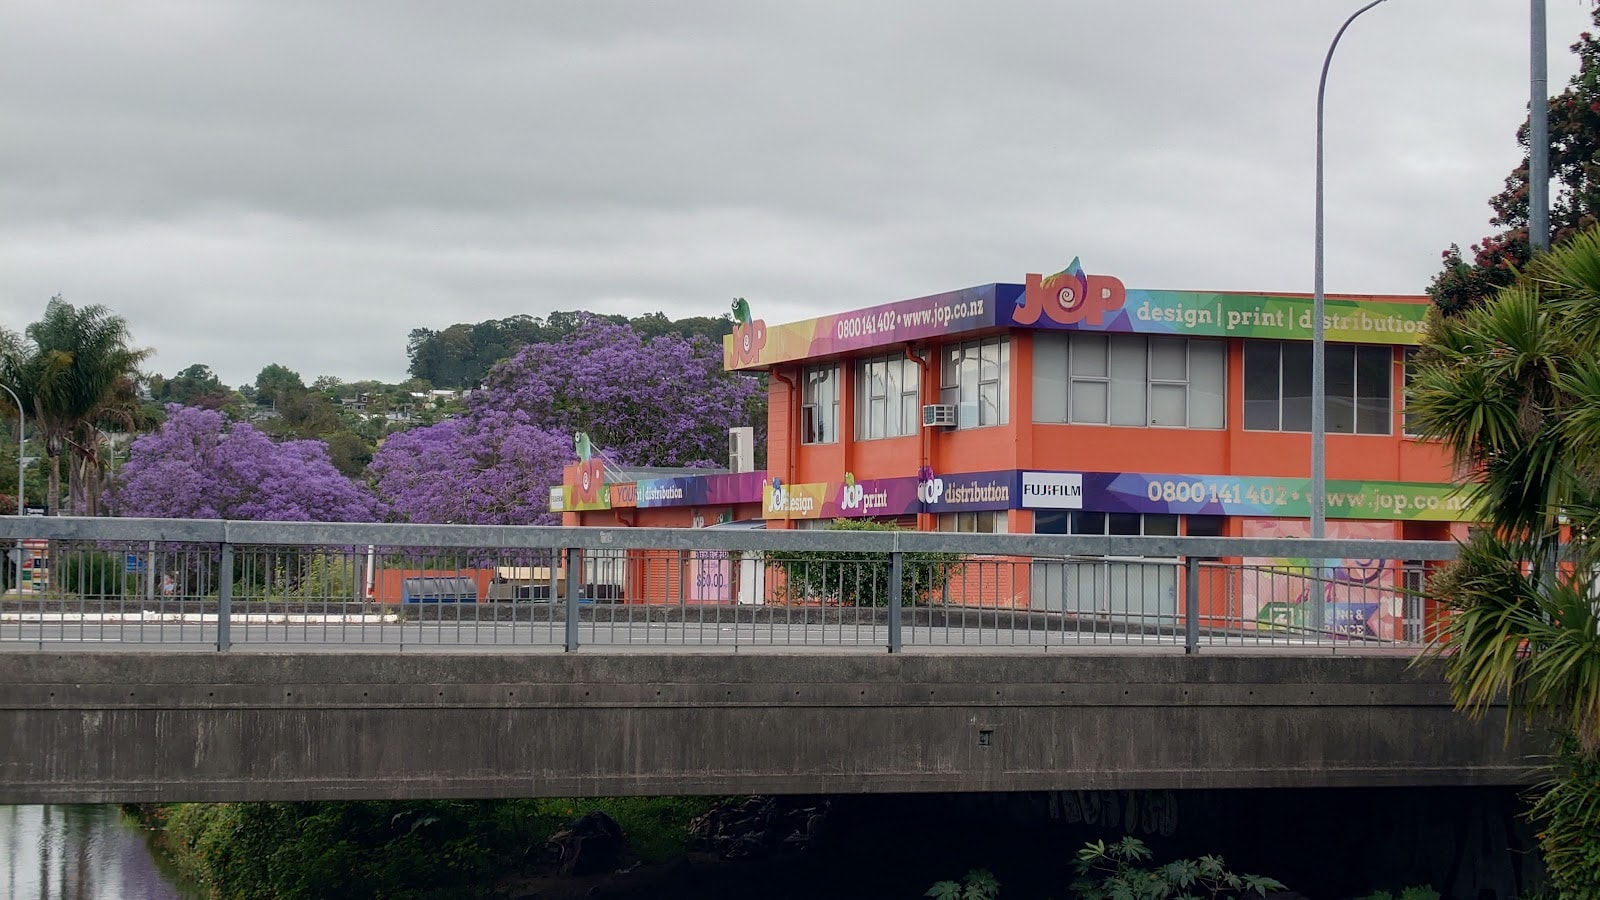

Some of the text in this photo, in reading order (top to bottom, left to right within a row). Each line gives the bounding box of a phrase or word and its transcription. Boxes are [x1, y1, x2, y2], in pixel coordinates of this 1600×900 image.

[1012, 273, 1127, 325] JOP
[837, 298, 984, 340] 0800 141 402 www.jop.co.nz
[1137, 301, 1429, 334] design print dstribution
[730, 318, 767, 369] JOP
[645, 484, 683, 501] distribution
[841, 483, 887, 513] JOP print
[945, 479, 1010, 504] distribution
[1024, 484, 1081, 497] FUJIFILM
[1147, 480, 1205, 504] 0800
[1209, 482, 1241, 505] 141
[1245, 482, 1288, 506] 402
